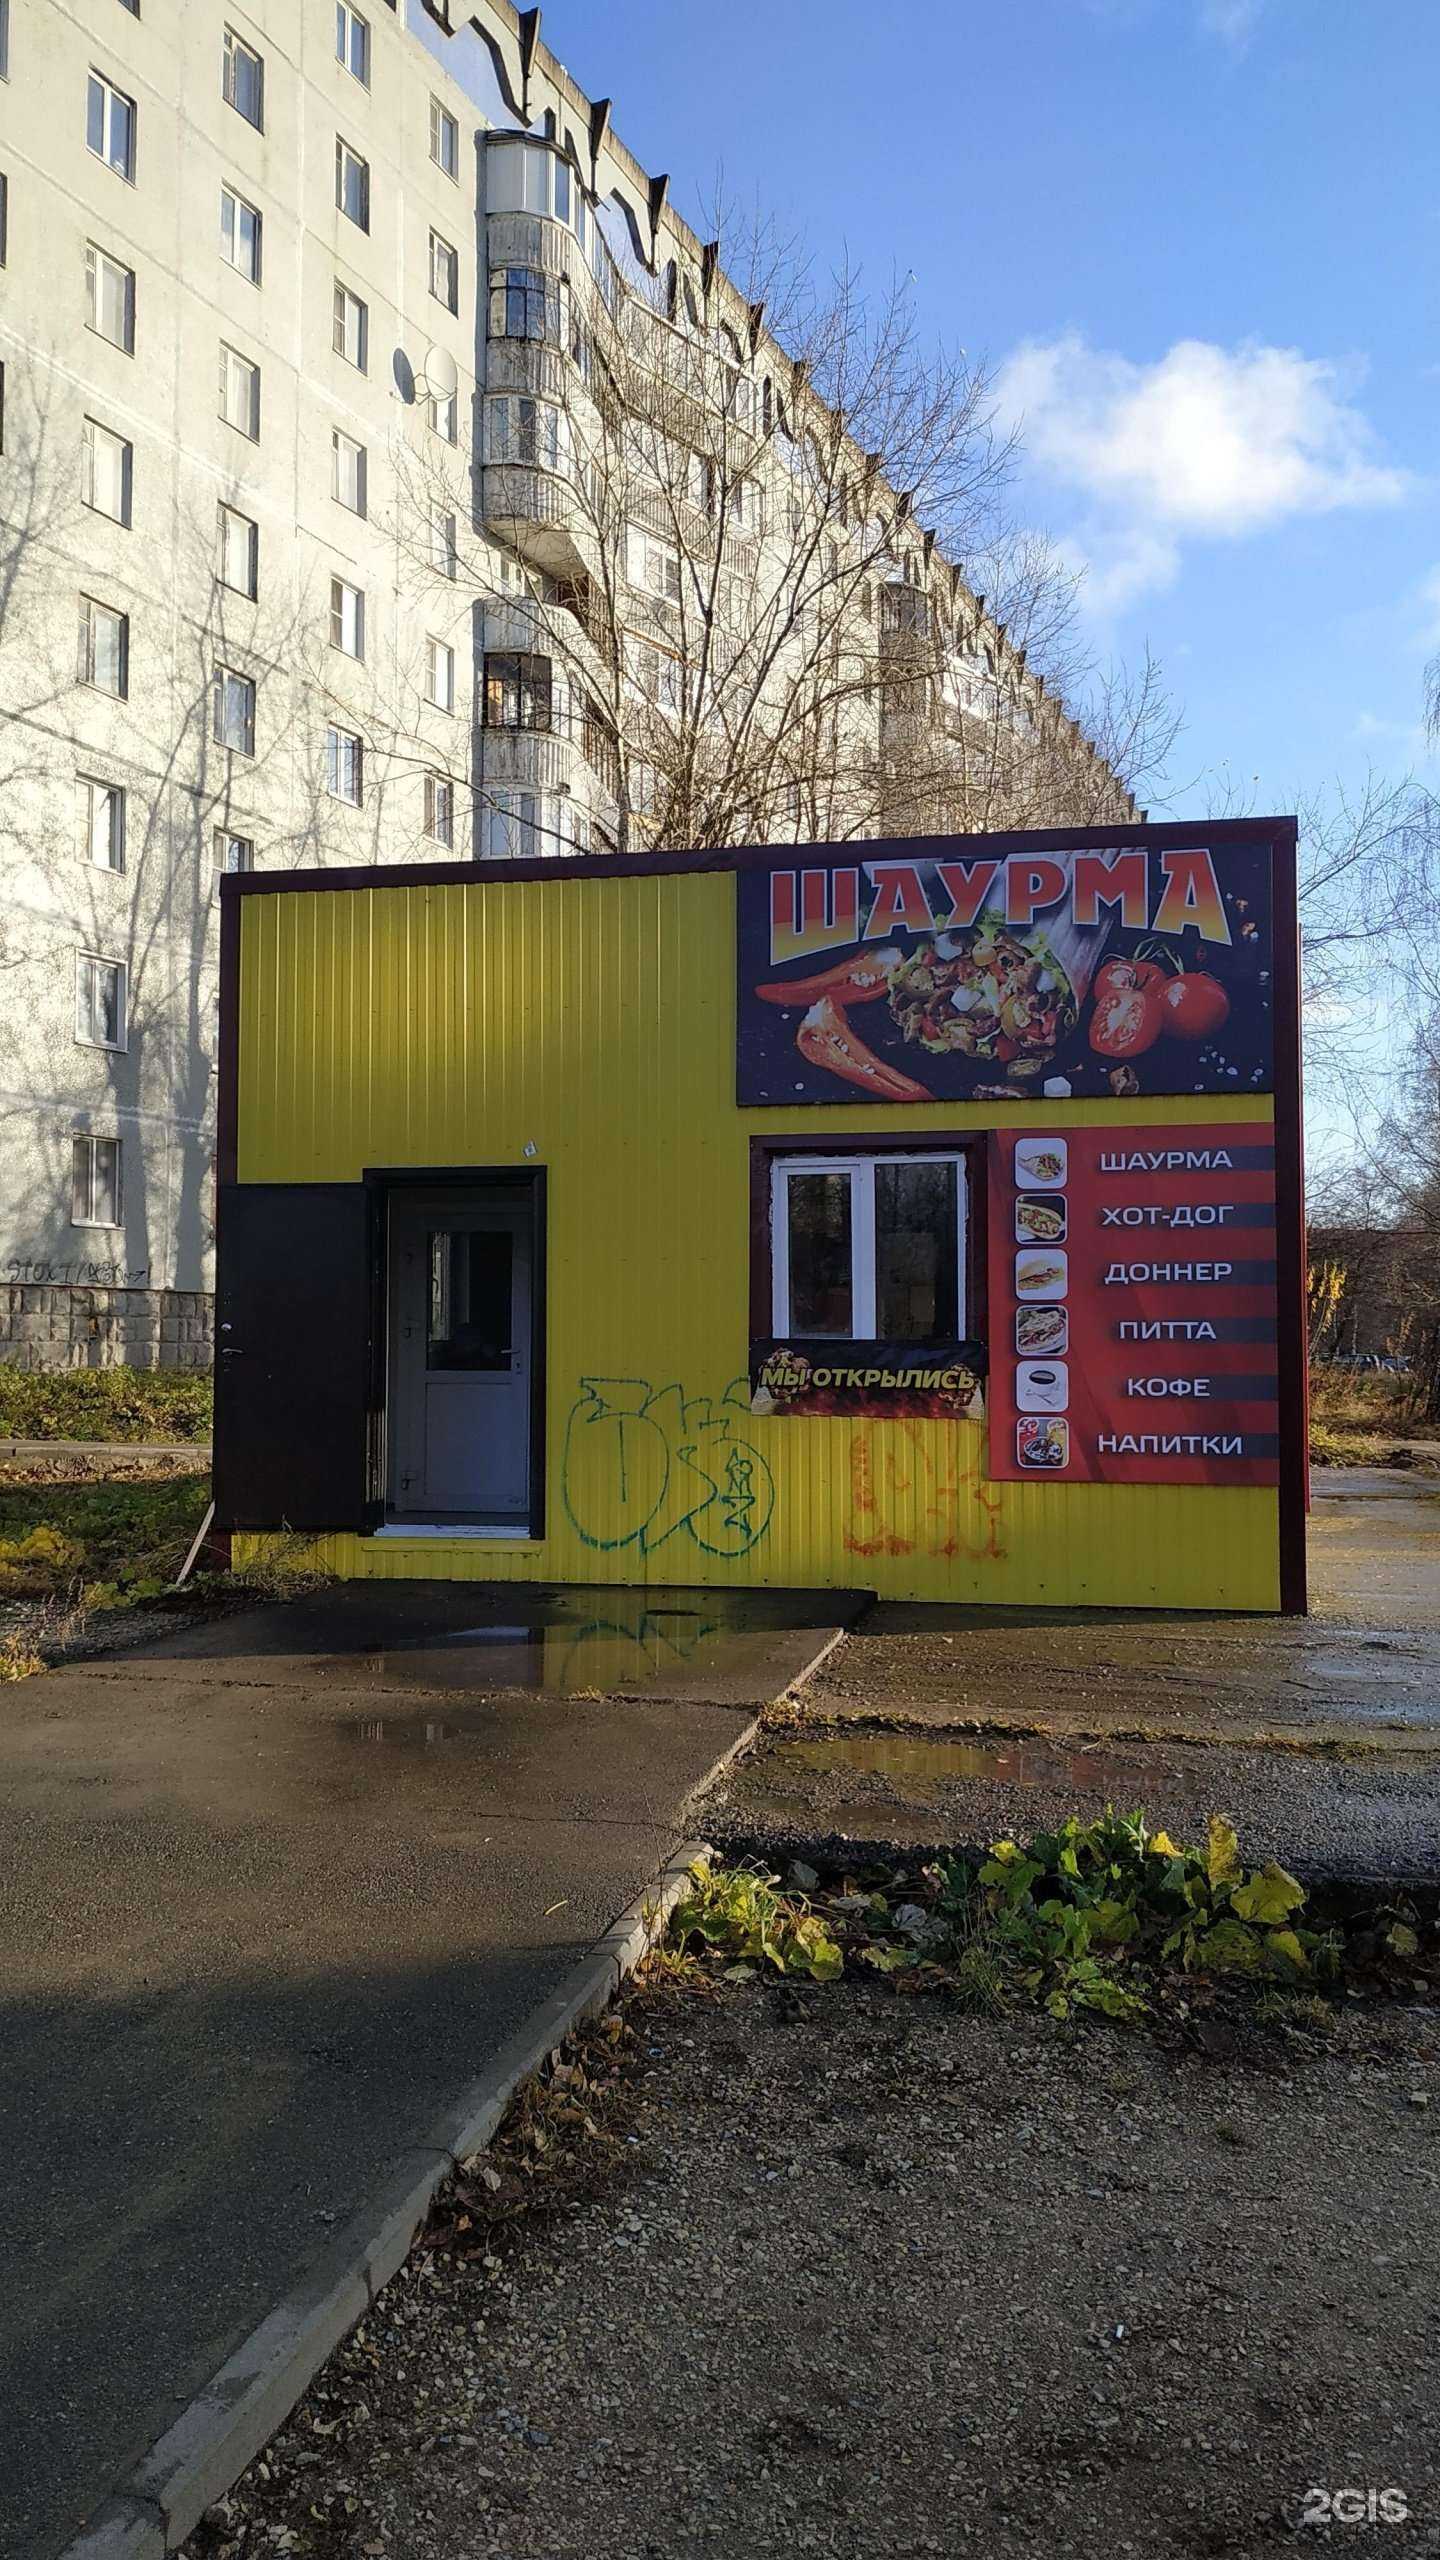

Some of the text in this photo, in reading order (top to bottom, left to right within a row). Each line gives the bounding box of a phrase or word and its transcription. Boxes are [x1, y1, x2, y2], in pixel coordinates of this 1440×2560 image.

[769, 848, 1232, 966] ШАУРМА
[1100, 1150, 1233, 1171] ШАУРМА
[1102, 1205, 1234, 1228] ХОТ-ДОГ
[1104, 1262, 1233, 1285] ДОННЕР
[1119, 1321, 1217, 1340] ПИТТА
[760, 1367, 975, 1389] МЫ ОТКРЫЛИСЬ
[1127, 1378, 1211, 1397] КОФЕ
[1098, 1434, 1243, 1455] НАПИТКИ
